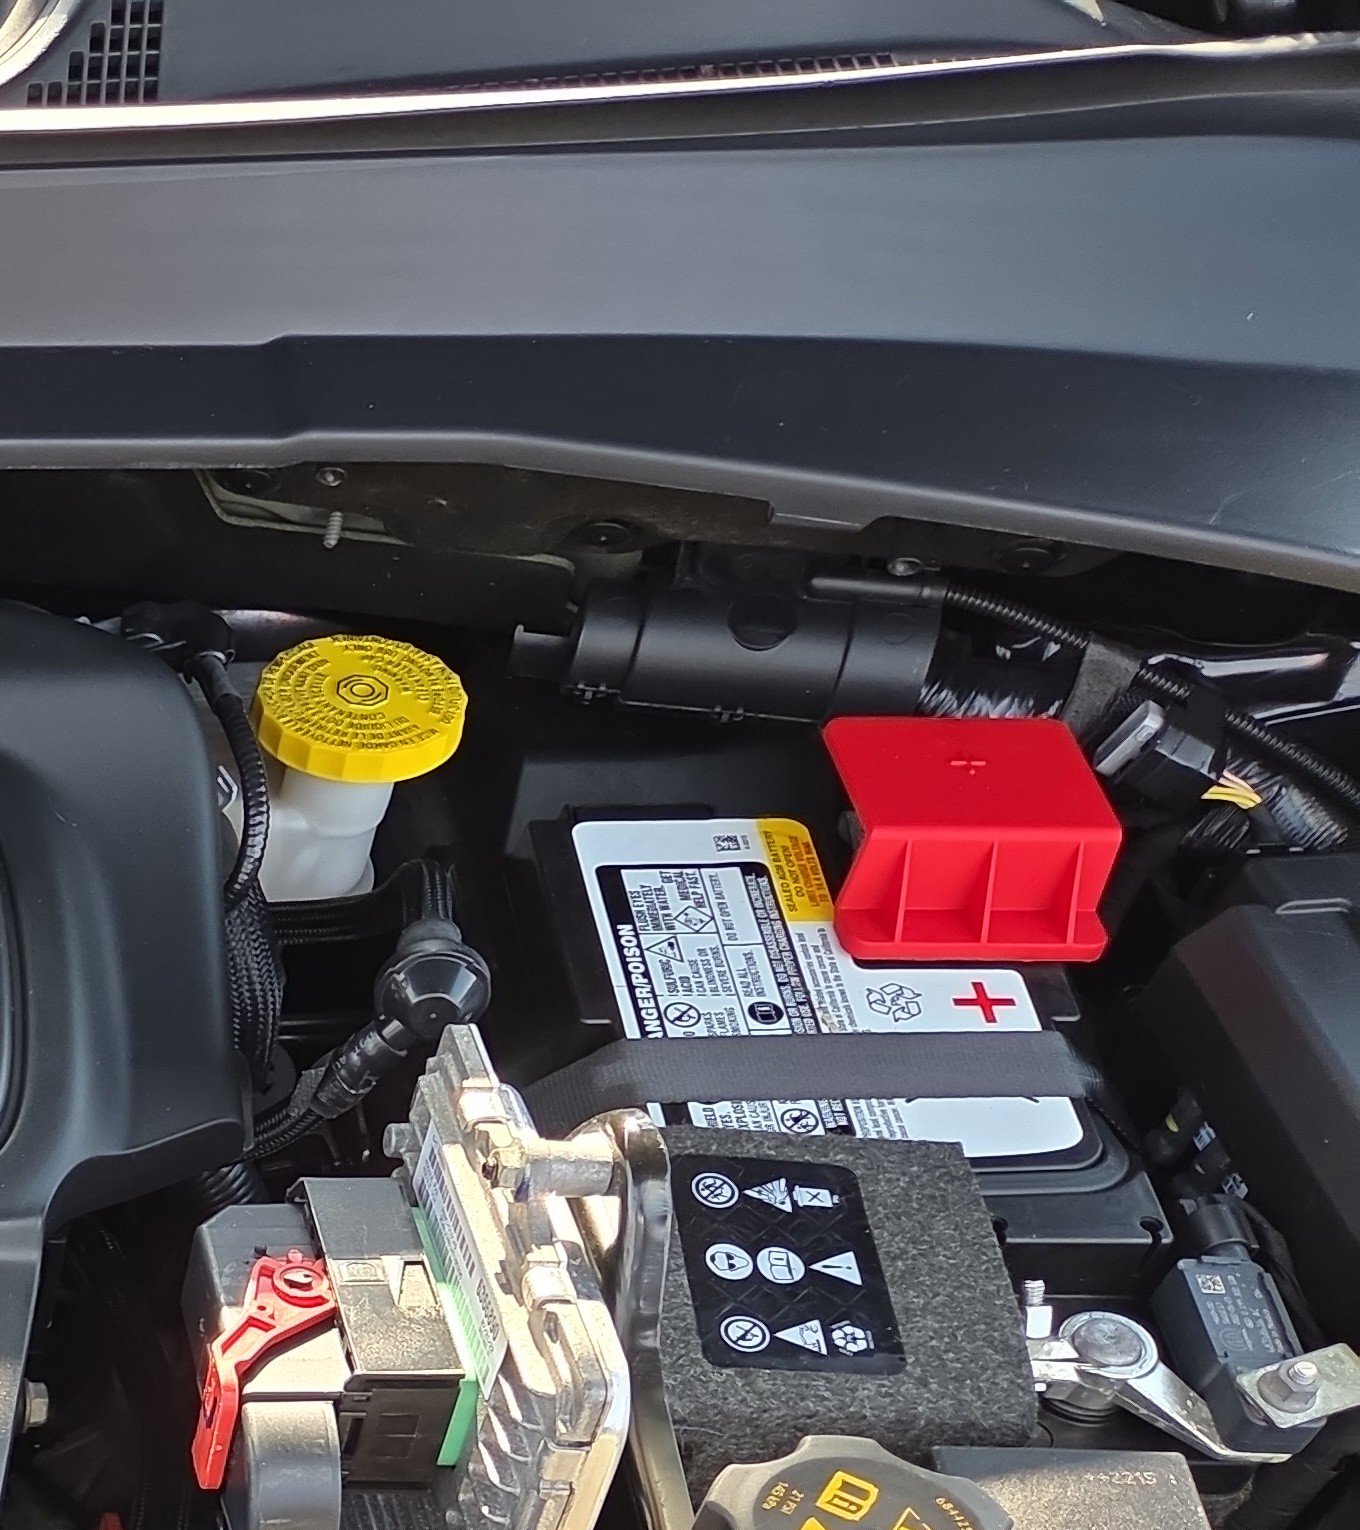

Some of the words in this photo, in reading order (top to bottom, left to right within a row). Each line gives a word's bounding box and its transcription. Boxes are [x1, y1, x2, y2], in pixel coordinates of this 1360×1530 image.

[627, 889, 644, 908] EYES
[638, 883, 664, 931] IMMEDIATELY
[632, 908, 651, 932] FLUSH
[615, 923, 664, 1037] ANGER/POISON
